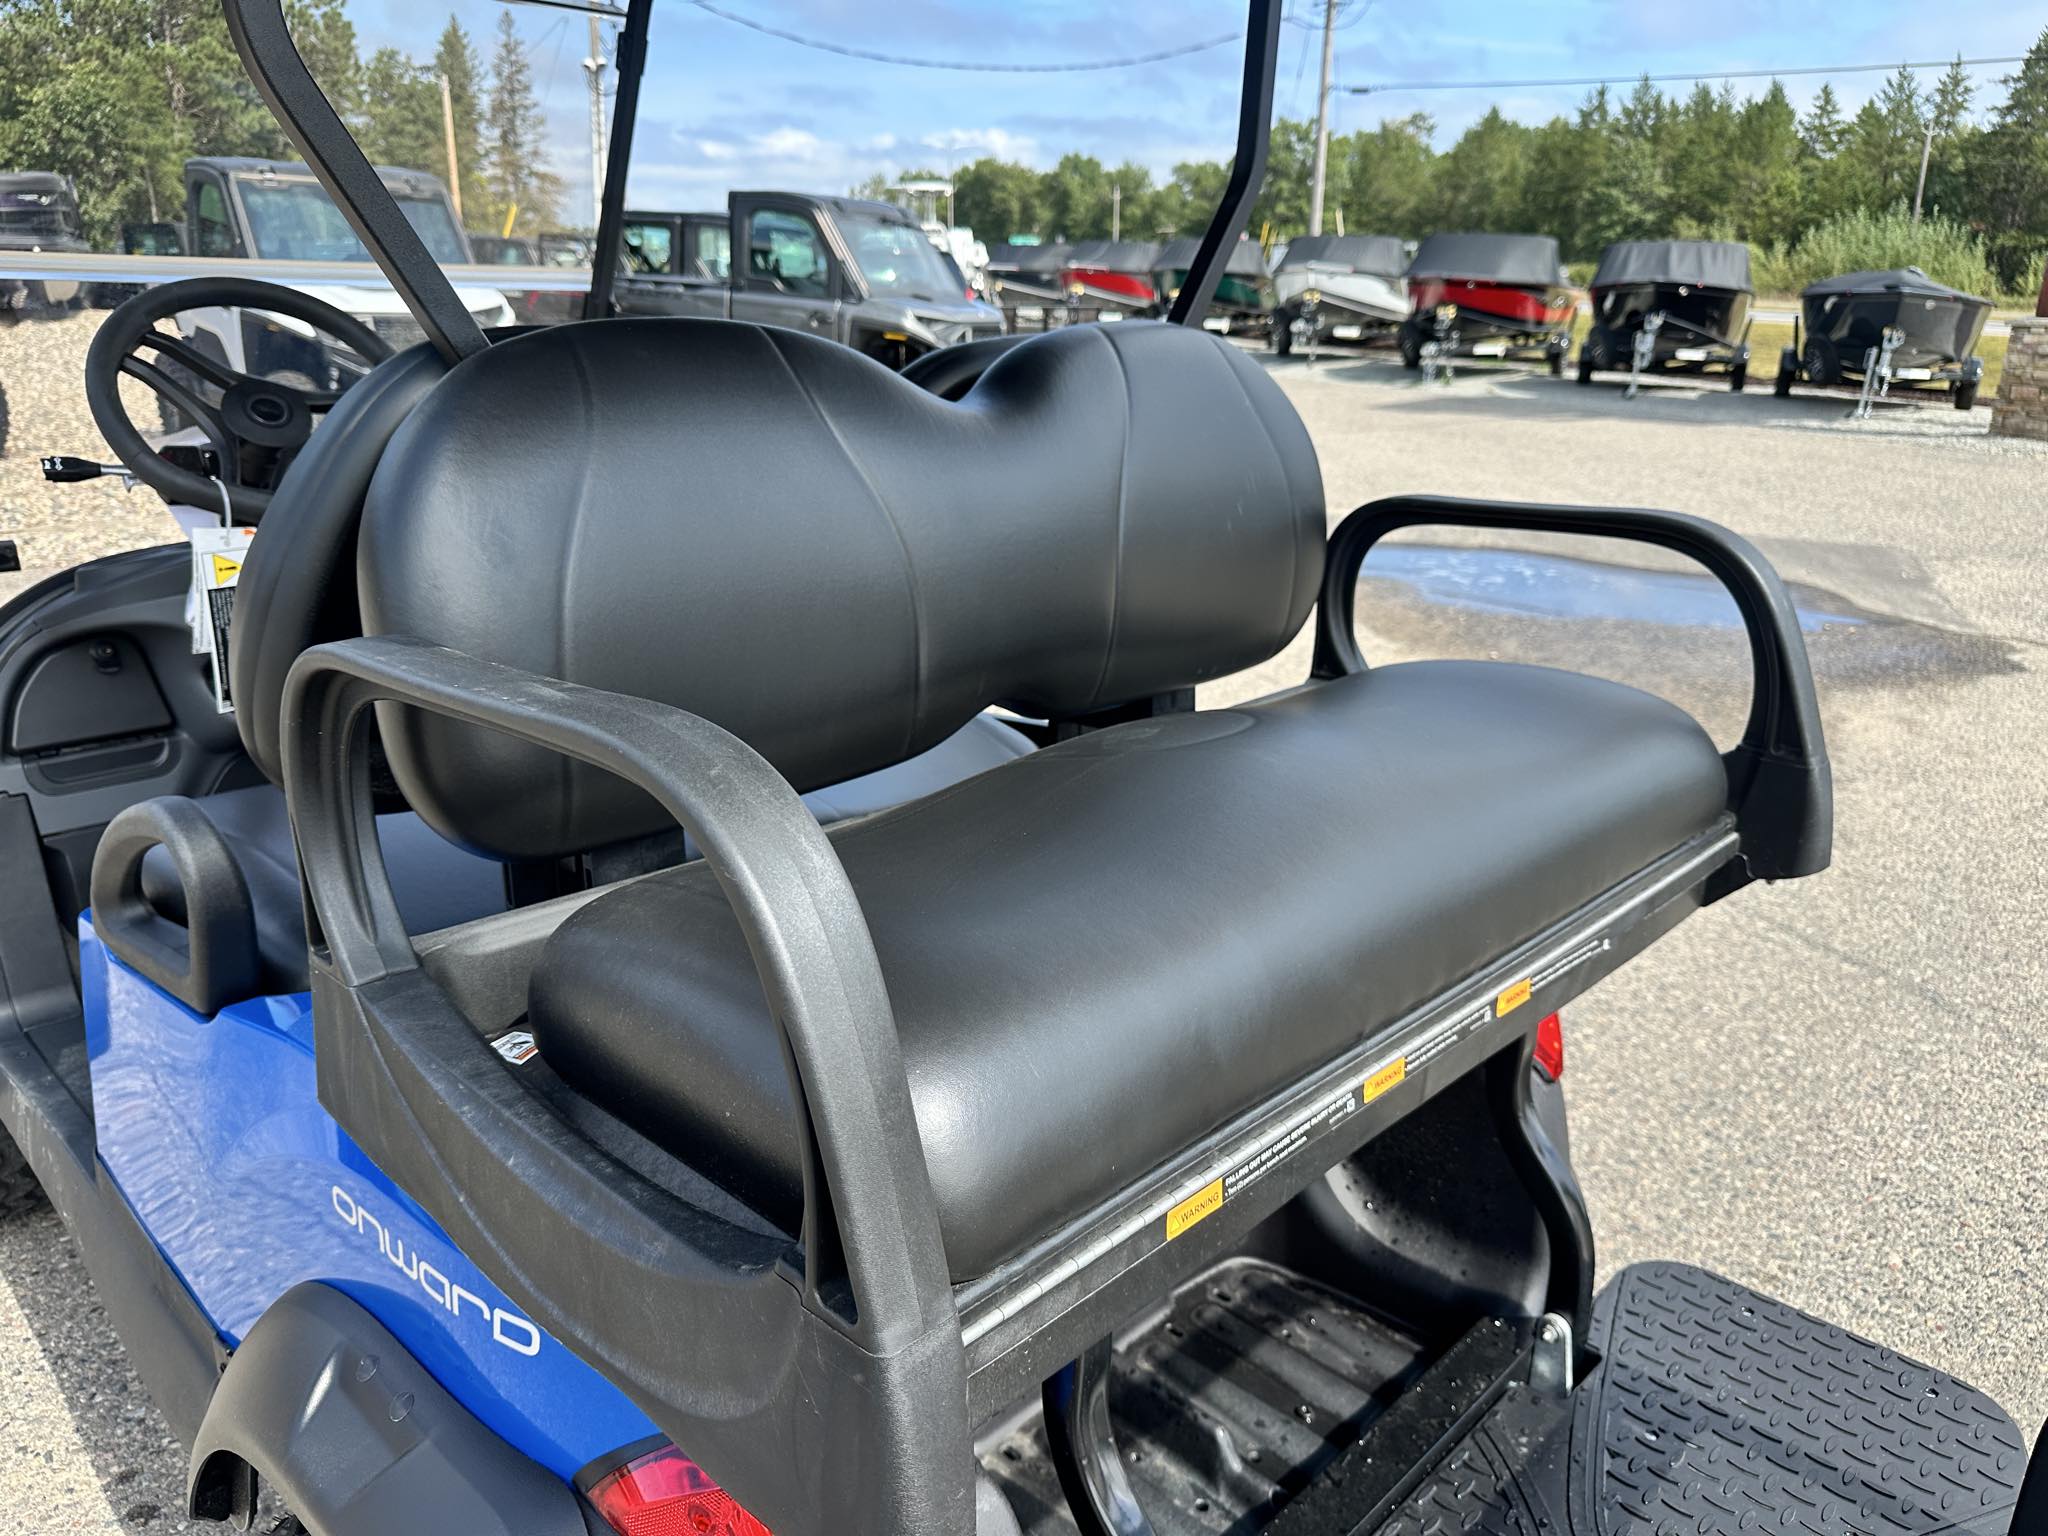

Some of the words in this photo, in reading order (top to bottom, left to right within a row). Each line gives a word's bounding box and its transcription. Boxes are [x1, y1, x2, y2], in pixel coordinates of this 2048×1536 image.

[1225, 1164, 1249, 1187] FALLING
[1248, 1155, 1261, 1171] OUT
[1260, 1147, 1273, 1162] MAY
[1272, 1134, 1291, 1154] CAUSE
[1180, 1191, 1220, 1224] WARNING
